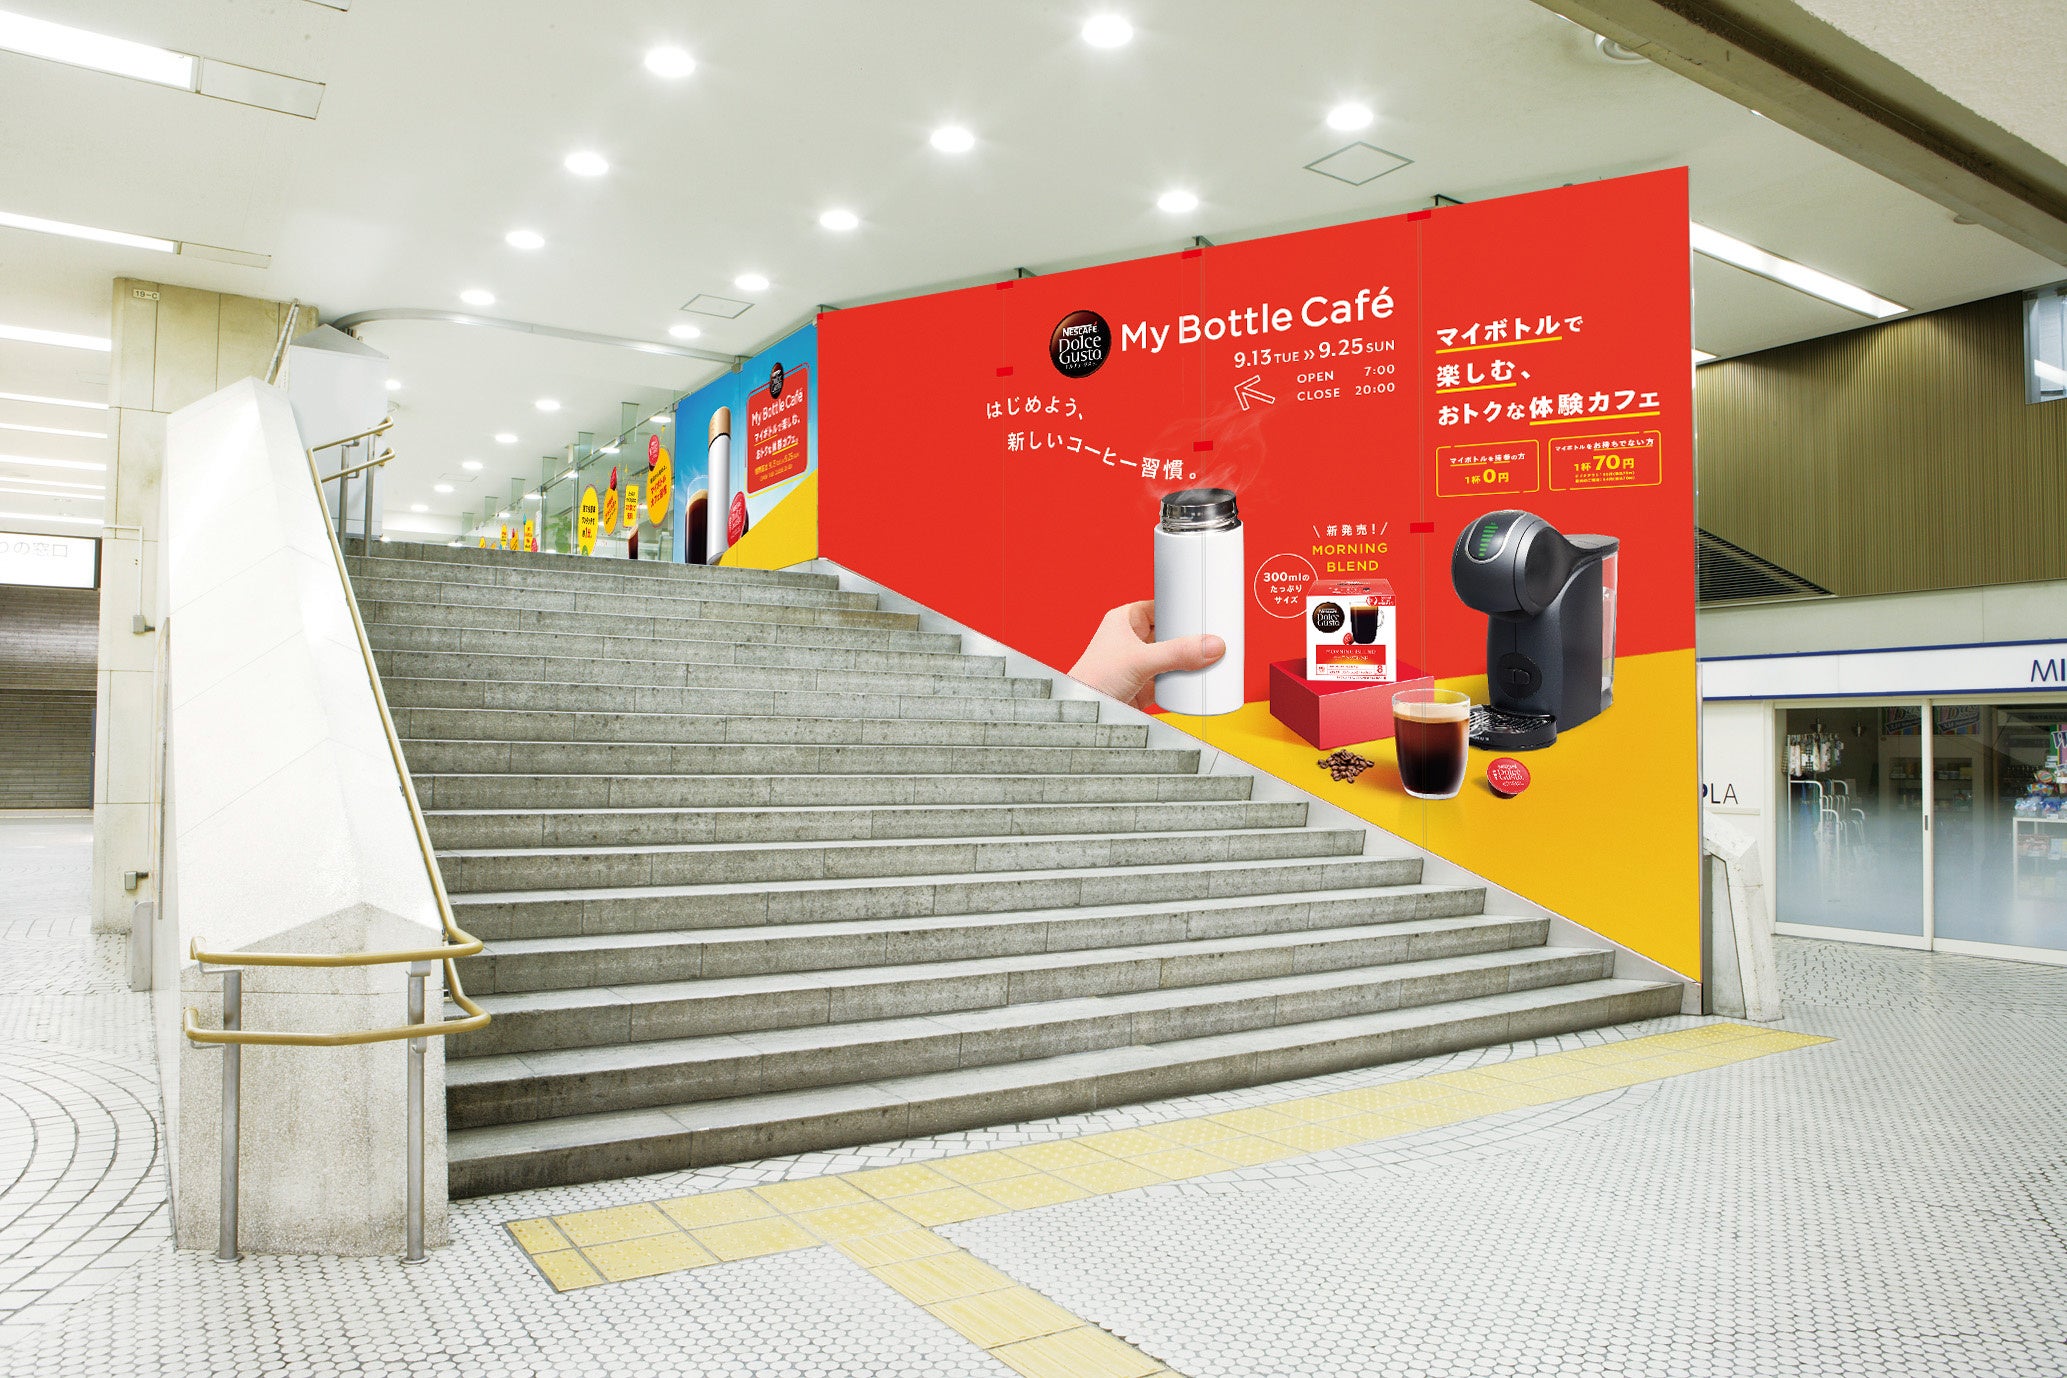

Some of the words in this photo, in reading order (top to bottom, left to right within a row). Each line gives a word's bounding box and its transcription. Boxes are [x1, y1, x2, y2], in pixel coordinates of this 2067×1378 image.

[135, 290, 158, 300] 19-C
[1062, 321, 1098, 337] NESCAFÉ
[1121, 322, 1170, 354] My
[1178, 303, 1293, 345] Bottle
[1300, 286, 1395, 329] Café
[1436, 314, 1584, 347] マイボトルで
[1059, 334, 1102, 352] Dolce
[1059, 348, 1102, 365] Gusto
[1234, 349, 1272, 369] 9.13
[1274, 351, 1300, 364] TUE
[1318, 340, 1364, 360] 9.25
[1366, 339, 1395, 354] SUN
[1296, 370, 1335, 384] OPEN
[1364, 364, 1396, 378] 7:00
[1436, 359, 1531, 387] 楽しむ、
[1297, 386, 1341, 401] CLOSE
[1355, 381, 1396, 396] 20:00
[986, 394, 1084, 421] はじめよう、
[1438, 389, 1661, 427] おトクな体験カフェ
[1007, 431, 1198, 481] 新しいコーヒー習慣。
[1573, 454, 1635, 472] 1杯70円
[1464, 468, 1510, 485] 1杯0円
[1312, 542, 1388, 556] MORNING
[1326, 560, 1379, 573] BLEND
[1263, 572, 1310, 583] 300mlの
[1270, 585, 1303, 594] たっぷり
[1274, 596, 1299, 605] サイズ
